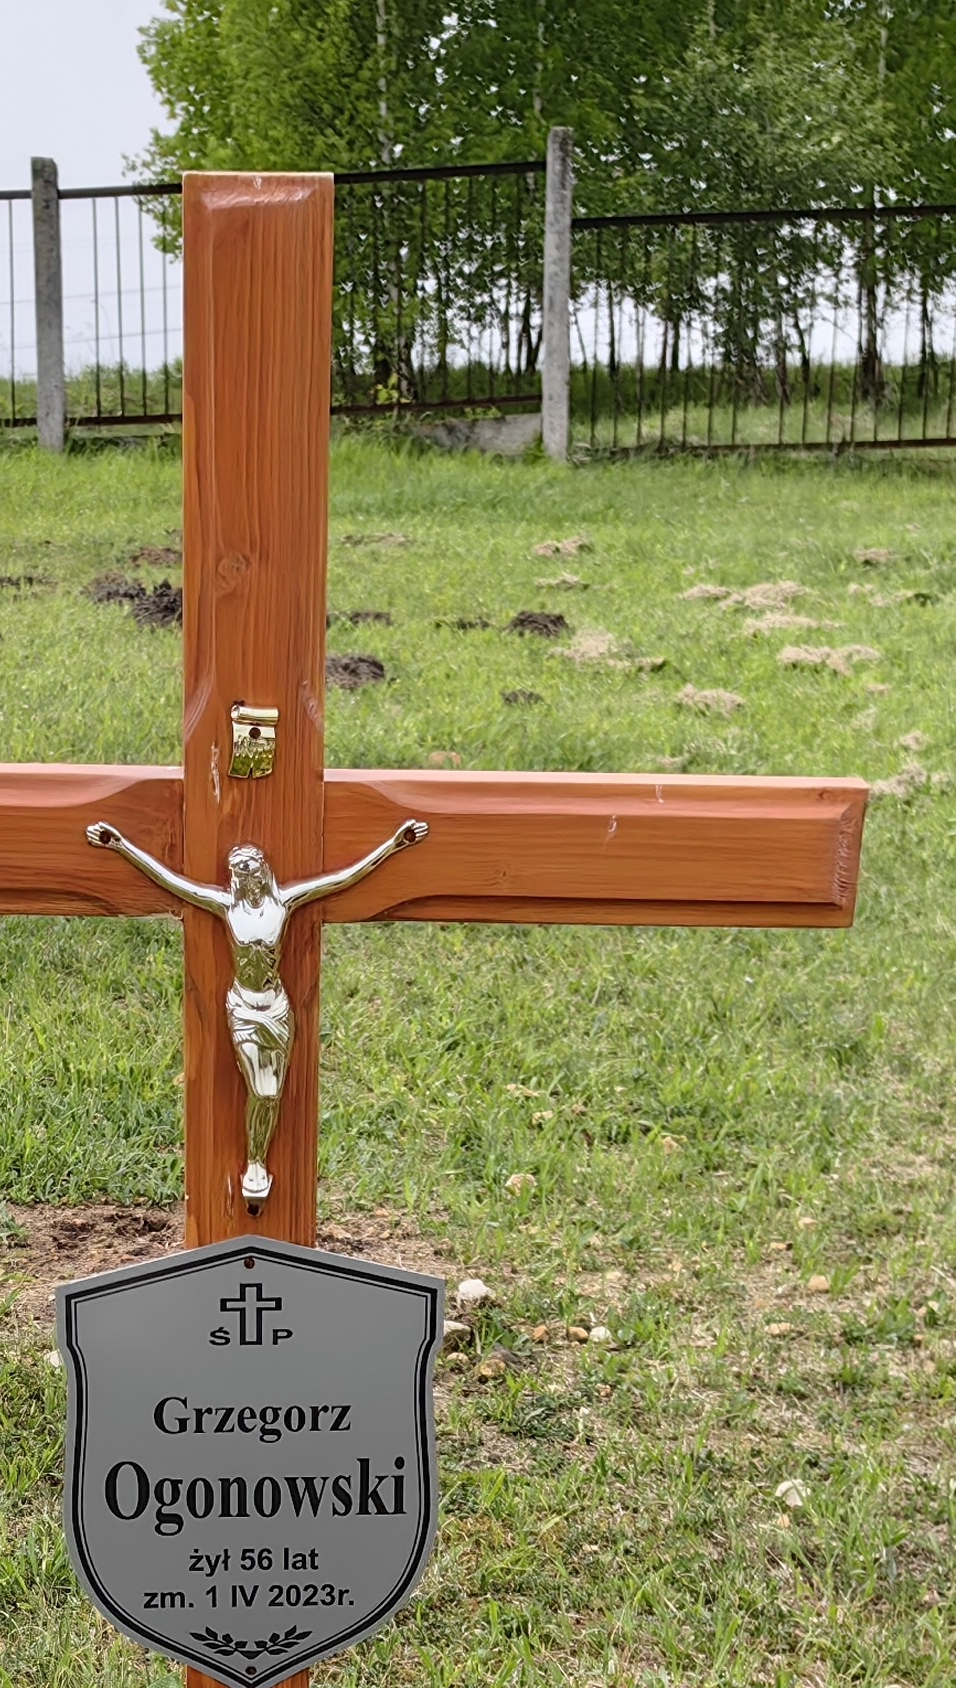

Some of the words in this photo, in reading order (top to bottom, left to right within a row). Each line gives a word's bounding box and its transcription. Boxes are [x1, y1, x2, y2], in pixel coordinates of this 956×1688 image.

[208, 1326, 231, 1346] Ś
[272, 1328, 294, 1346] P
[153, 1396, 352, 1443] Grzegorz
[104, 1456, 407, 1537] Ogonowski
[188, 1548, 232, 1578] żył
[240, 1547, 274, 1572] 56
[283, 1546, 320, 1571] lat
[143, 1591, 195, 1610] zm.
[205, 1584, 218, 1609] 1
[231, 1584, 260, 1608] IV
[267, 1583, 355, 1608] 2023r.
